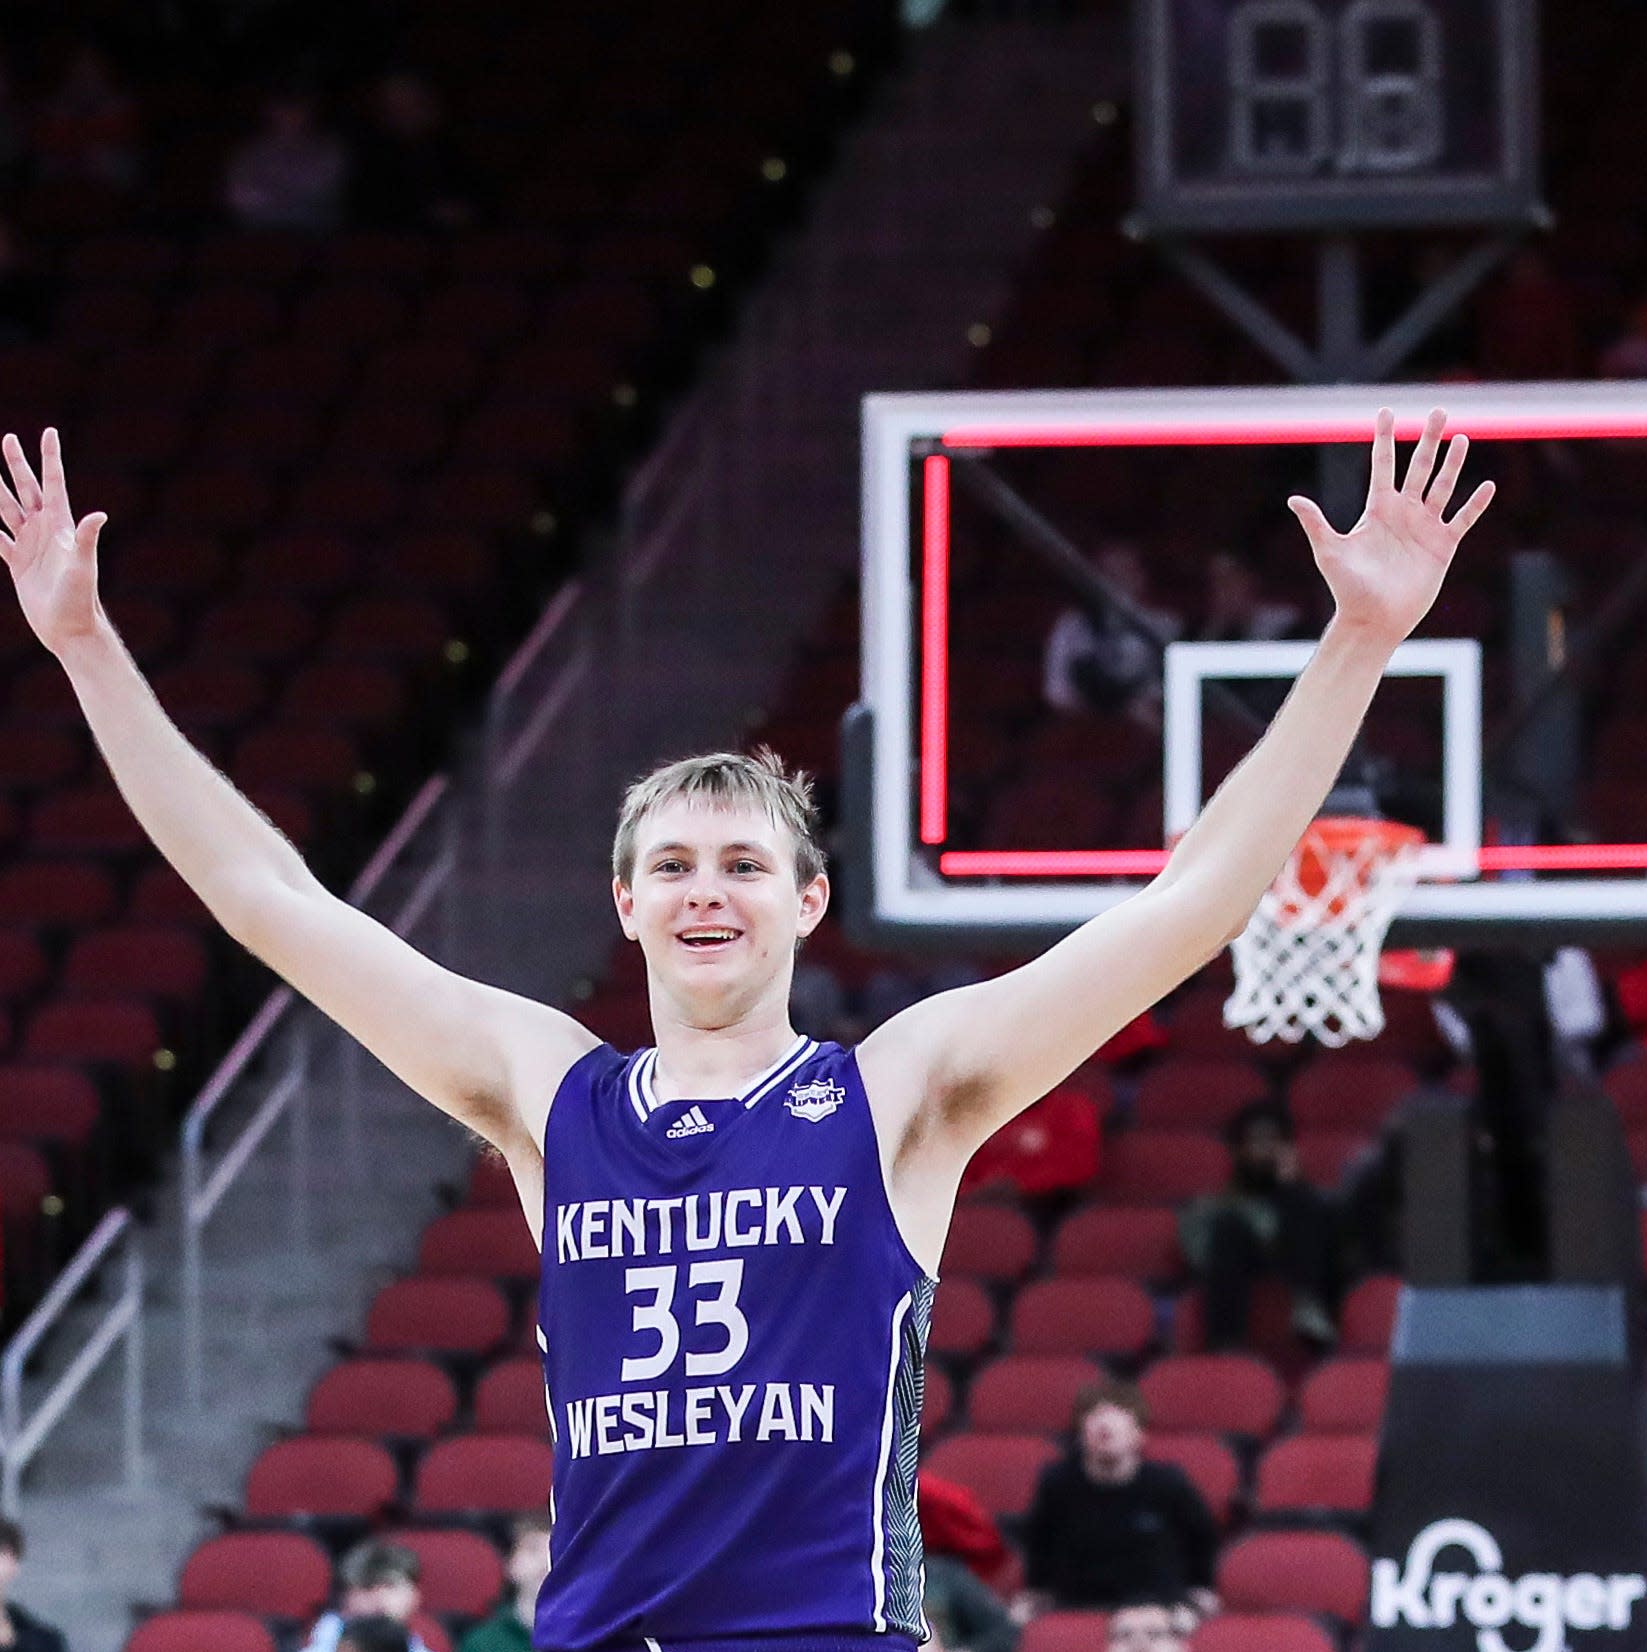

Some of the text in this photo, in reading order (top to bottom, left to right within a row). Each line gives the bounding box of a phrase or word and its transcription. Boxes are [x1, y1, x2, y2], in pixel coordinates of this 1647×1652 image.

[666, 1123, 714, 1139] adidas
[557, 1185, 848, 1264] KENTUCKY
[620, 1257, 750, 1383] 33
[566, 1382, 835, 1460] WESLEYAN
